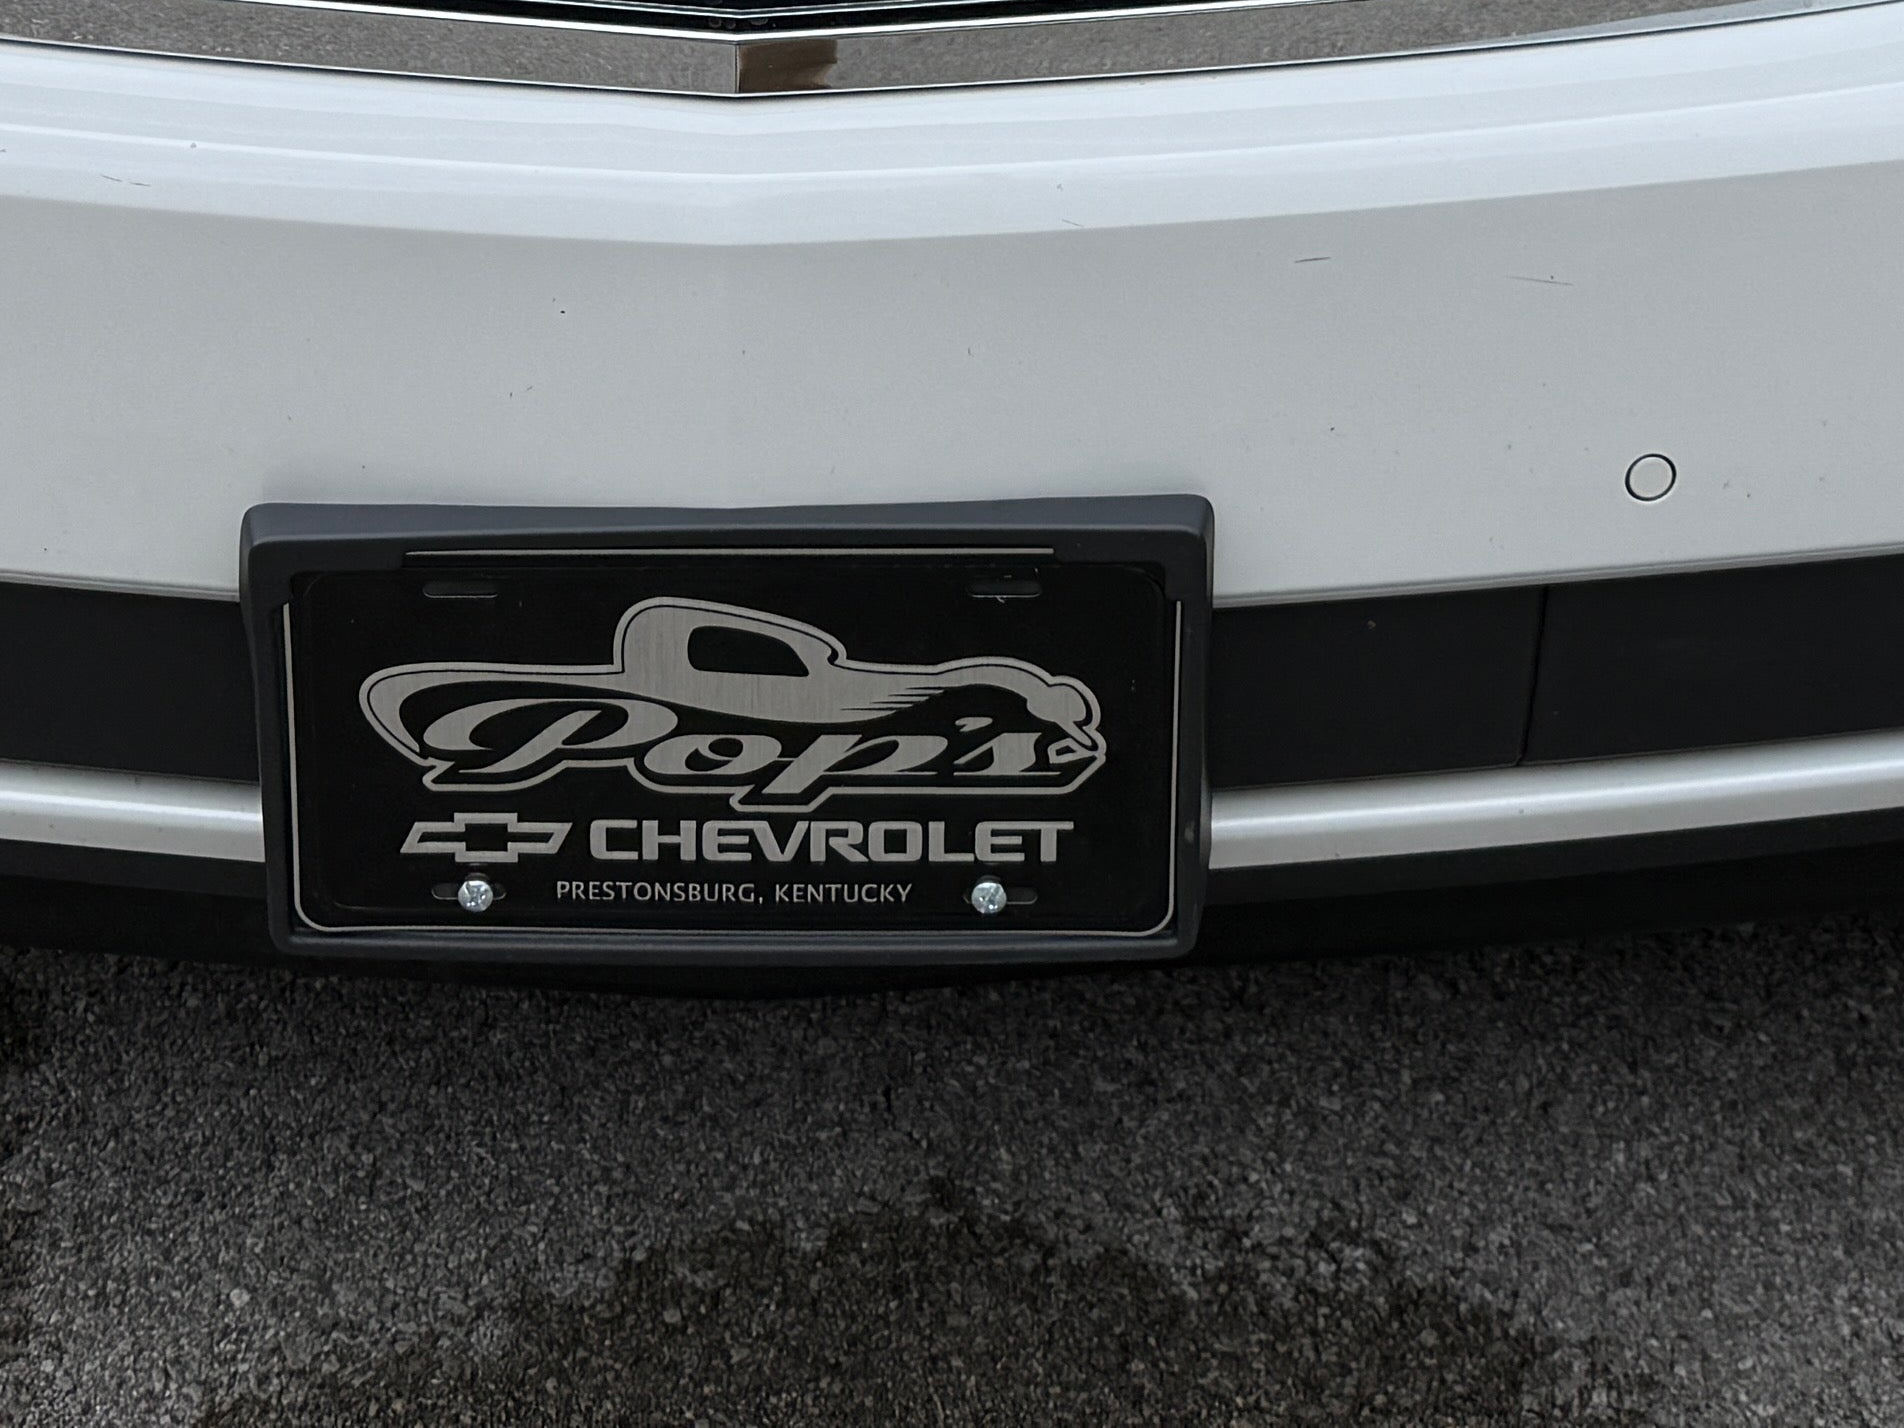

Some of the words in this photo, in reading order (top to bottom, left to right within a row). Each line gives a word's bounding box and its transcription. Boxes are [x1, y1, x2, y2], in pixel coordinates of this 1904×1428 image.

[423, 697, 1062, 794] Pop's
[589, 818, 1075, 863] CHEVROLET
[555, 879, 765, 906] PRESTONSBURG,
[774, 880, 914, 904] KENTUCKY
